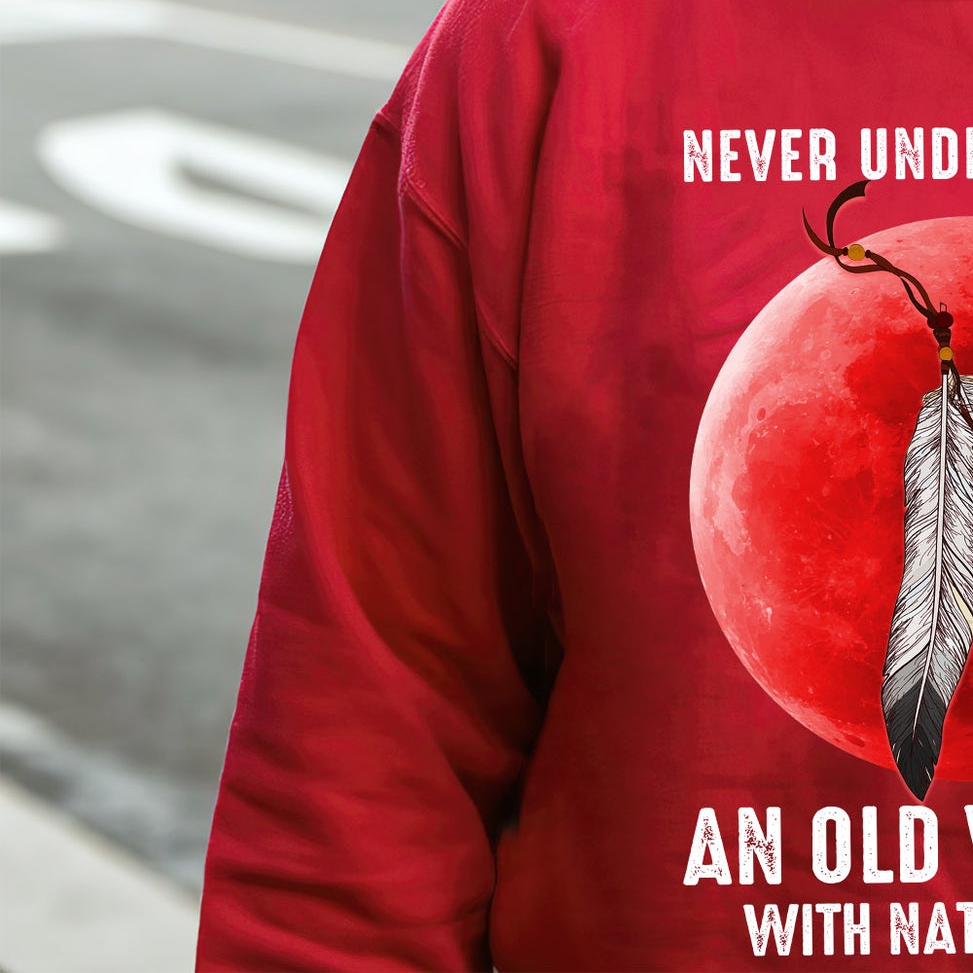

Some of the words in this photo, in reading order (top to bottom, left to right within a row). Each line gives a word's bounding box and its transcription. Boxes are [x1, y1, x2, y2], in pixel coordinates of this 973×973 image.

[684, 129, 836, 182] NEVER
[684, 807, 781, 885] AN
[812, 805, 938, 884] OLD
[743, 903, 870, 956] WITH
